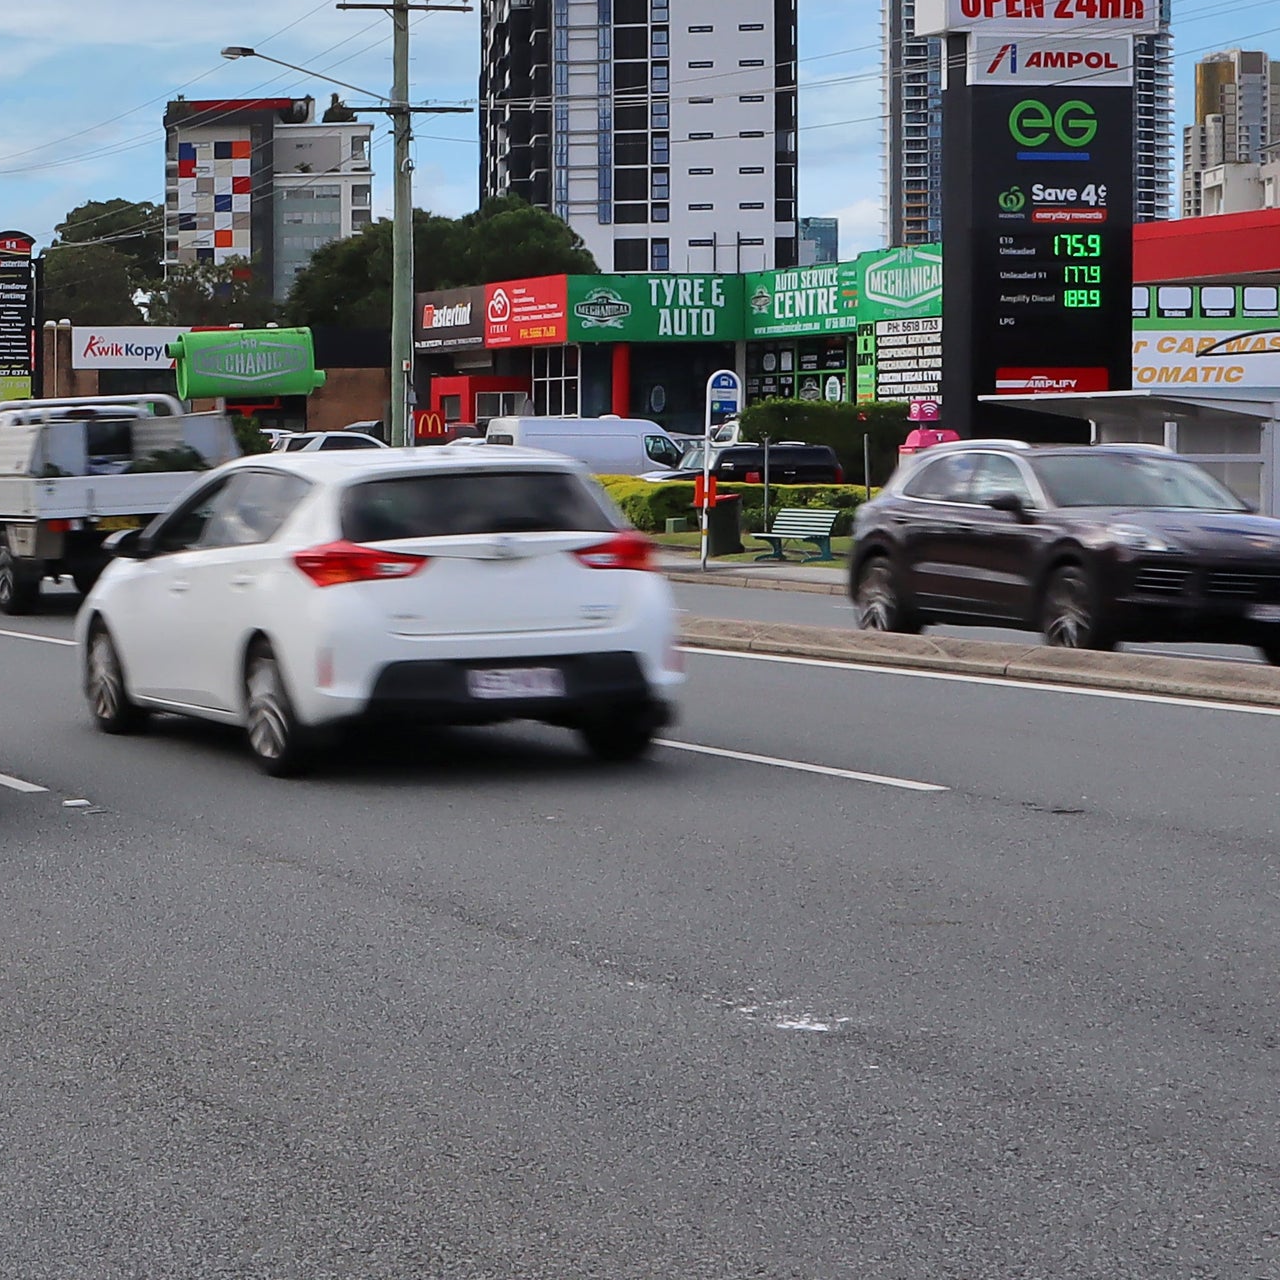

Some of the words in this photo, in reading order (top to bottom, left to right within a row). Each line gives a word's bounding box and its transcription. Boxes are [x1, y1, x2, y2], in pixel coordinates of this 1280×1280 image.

[1024, 51, 1119, 69] AMPOL
[1031, 183, 1078, 202] Save
[1035, 211, 1071, 220] everyday
[1071, 211, 1103, 220] rewards
[999, 236, 1014, 245] E10
[1053, 234, 1101, 257] 175.9
[999, 247, 1036, 256] Unleaded
[774, 272, 798, 292] AUTO
[800, 267, 839, 289] SERVICE
[1000, 271, 1037, 279] Unleaded
[648, 278, 705, 307] TYRE
[1000, 294, 1031, 304] Amplify
[1031, 294, 1056, 302] Diesel
[1063, 289, 1101, 308] 189.9
[774, 286, 839, 319] CENTRE
[577, 304, 629, 317] MECHANICAL
[658, 308, 716, 336] AUTO
[901, 321, 920, 333] 5618
[999, 318, 1015, 326] LPG
[240, 338, 257, 349] MR
[1156, 336, 1217, 354] CAR
[1026, 379, 1078, 389] AMPLIFY
